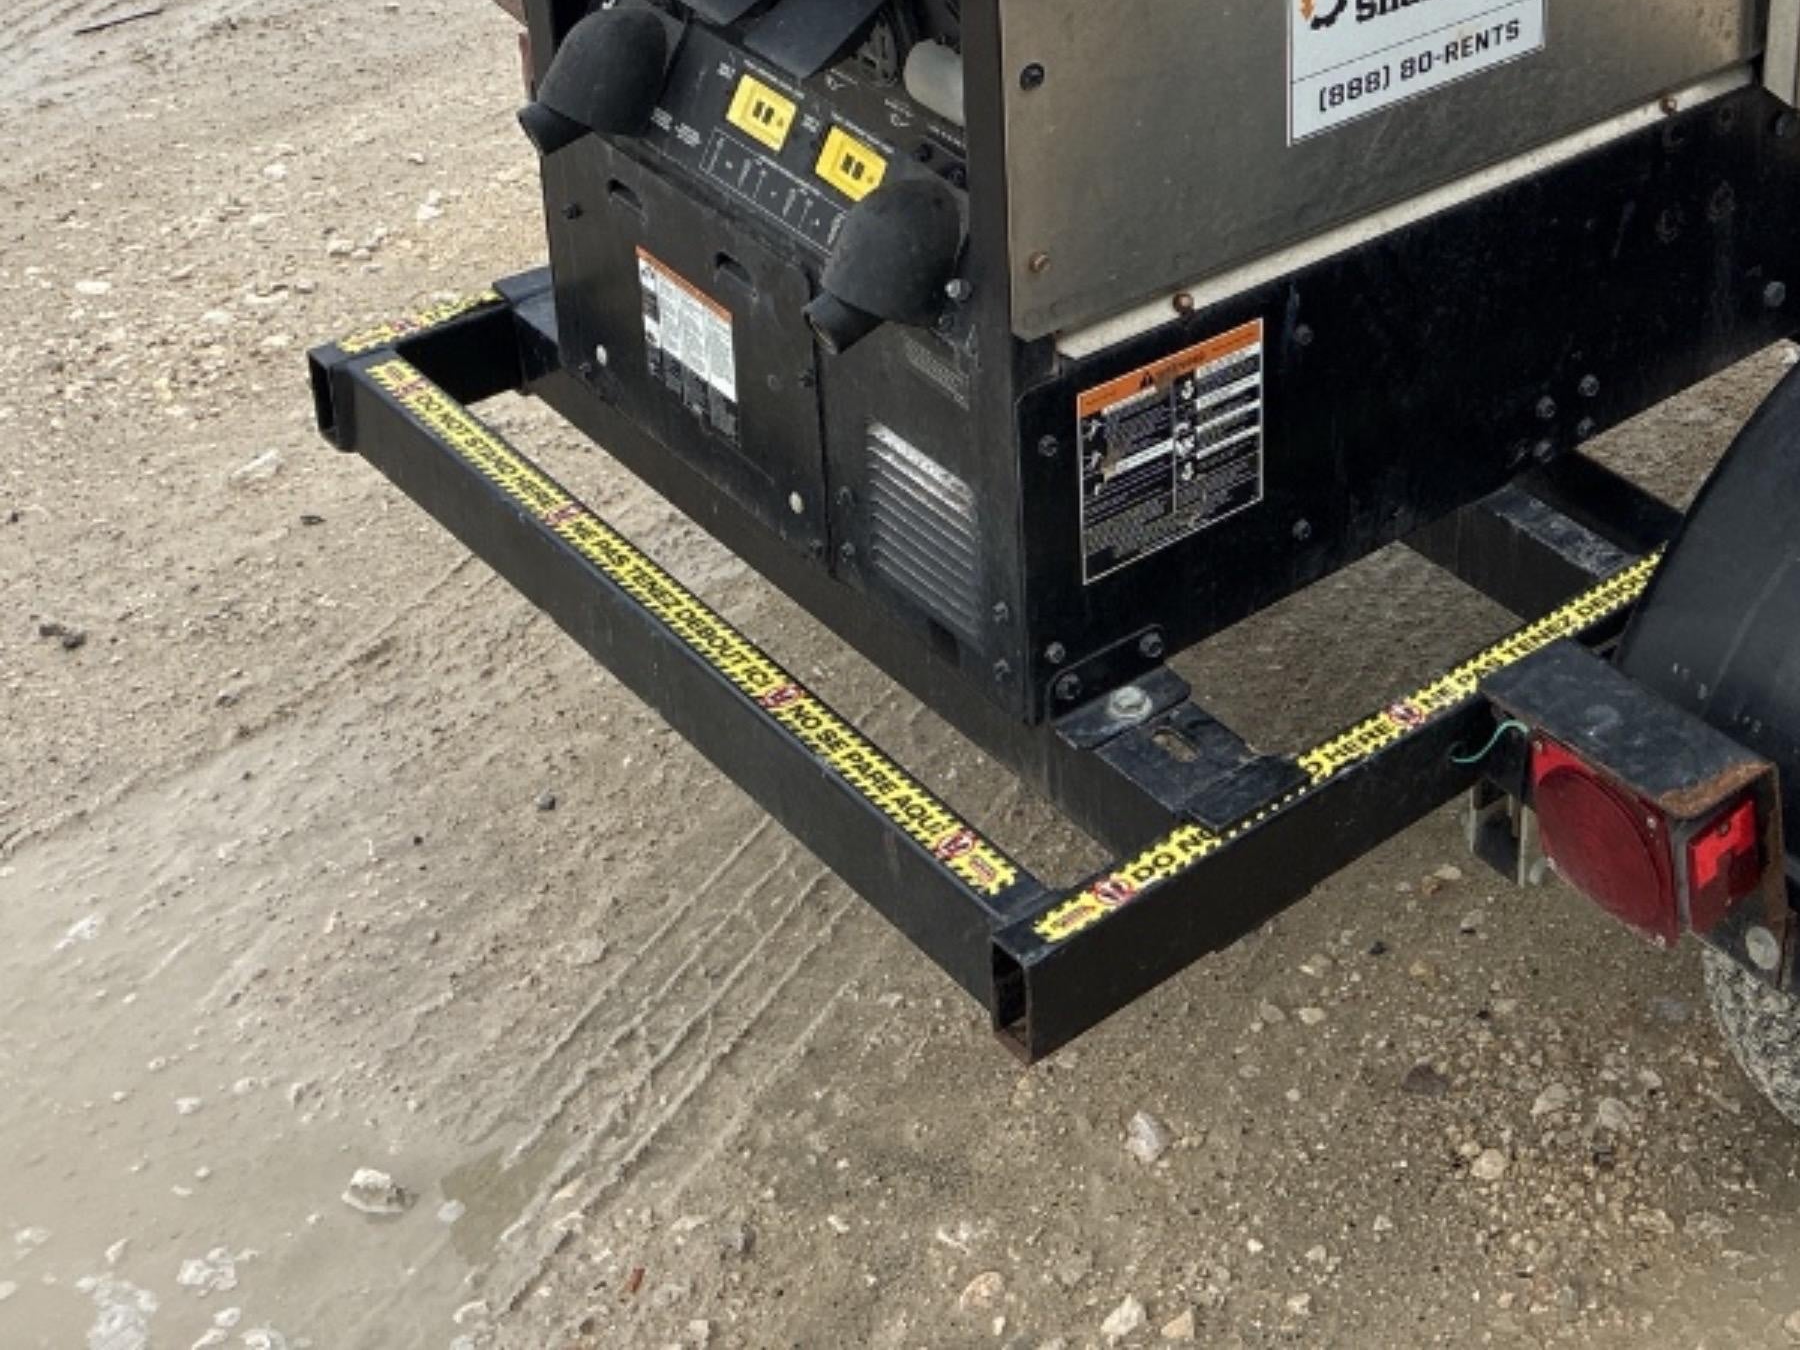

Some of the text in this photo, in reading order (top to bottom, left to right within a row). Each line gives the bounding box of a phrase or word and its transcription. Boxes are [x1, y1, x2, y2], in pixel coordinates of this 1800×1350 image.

[1318, 19, 1521, 112] (888) 80-RENTS
[415, 392, 443, 413] DO
[440, 409, 474, 437] NOT
[465, 436, 518, 476] STAND
[591, 538, 631, 568] PAS
[625, 564, 683, 610] TENEZ
[677, 607, 756, 667] DEBOUT
[741, 663, 775, 690] ICI
[788, 702, 823, 731] NO
[816, 728, 850, 754] SE
[844, 750, 898, 794] PARE
[1322, 720, 1396, 761] HERE
[1502, 615, 1570, 657] TENEZ
[1130, 851, 1176, 882] DO
